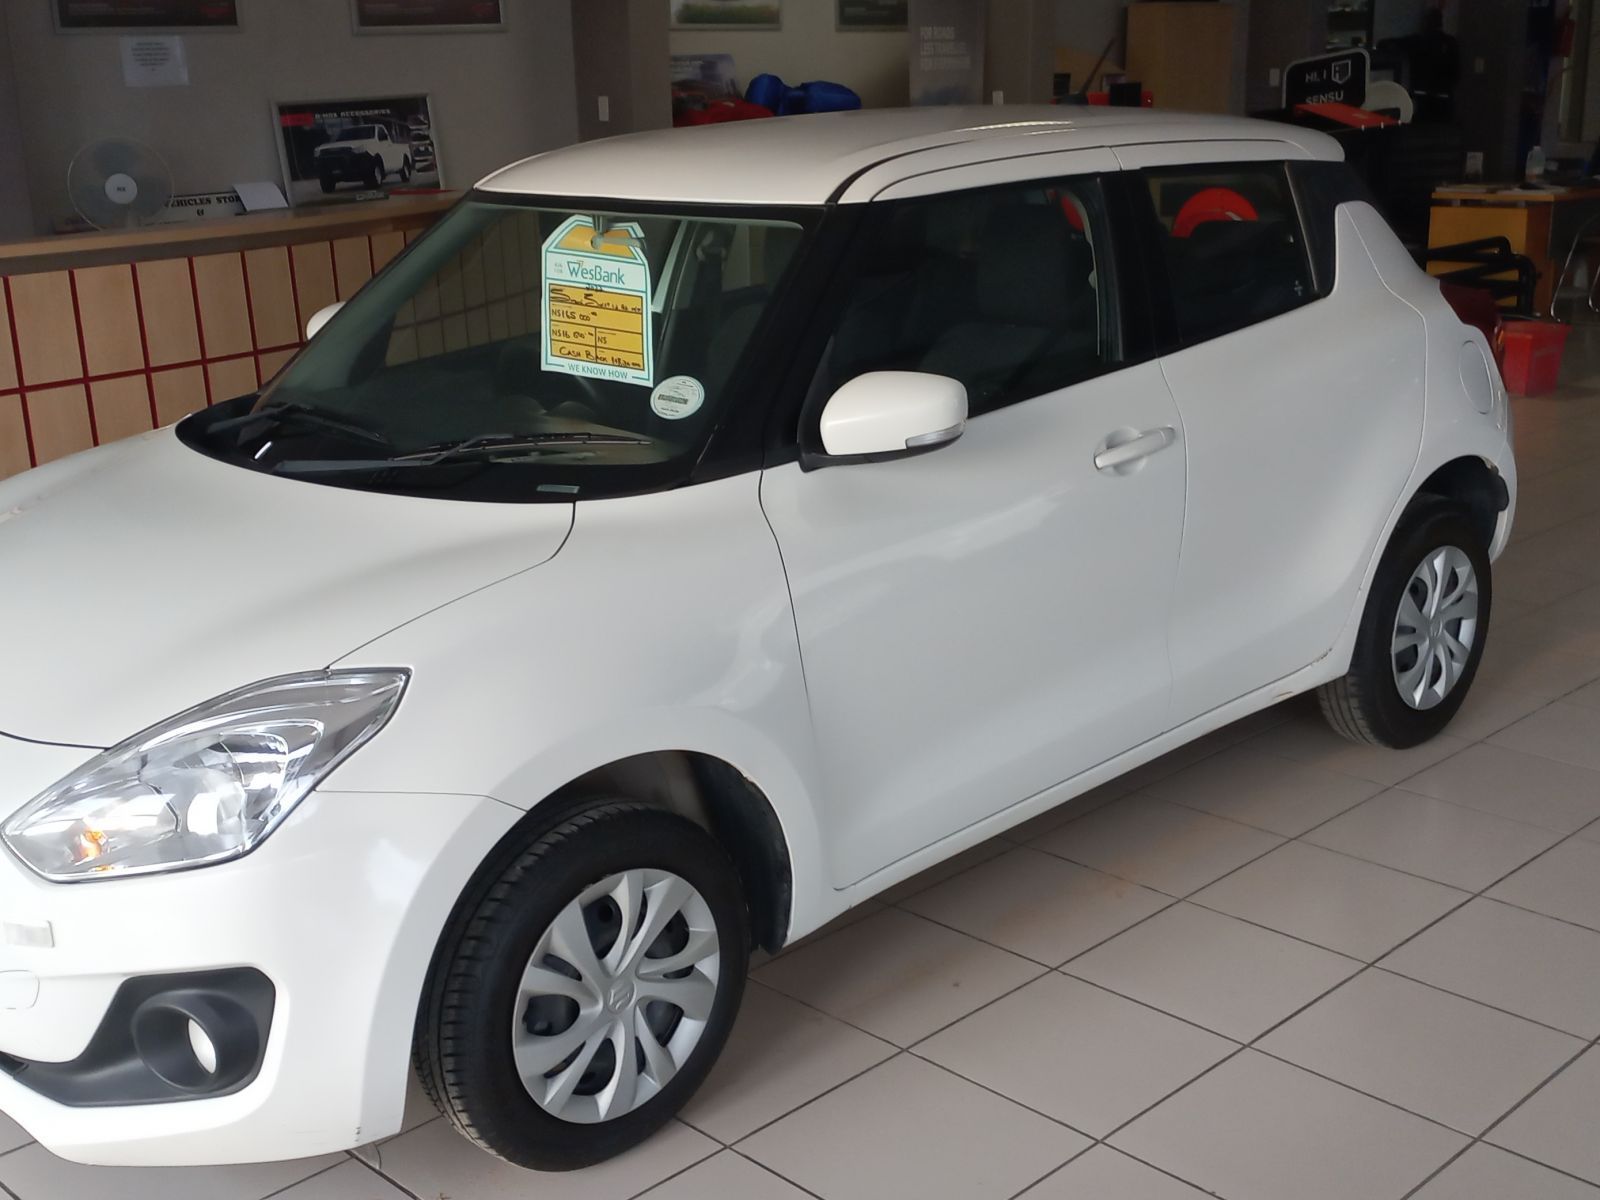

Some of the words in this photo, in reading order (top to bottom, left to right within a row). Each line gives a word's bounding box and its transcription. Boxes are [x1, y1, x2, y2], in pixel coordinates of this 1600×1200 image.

[567, 261, 625, 285] WesBank
[567, 363, 580, 373] WE
[582, 365, 606, 377] KNOW
[608, 369, 628, 379] HOW
